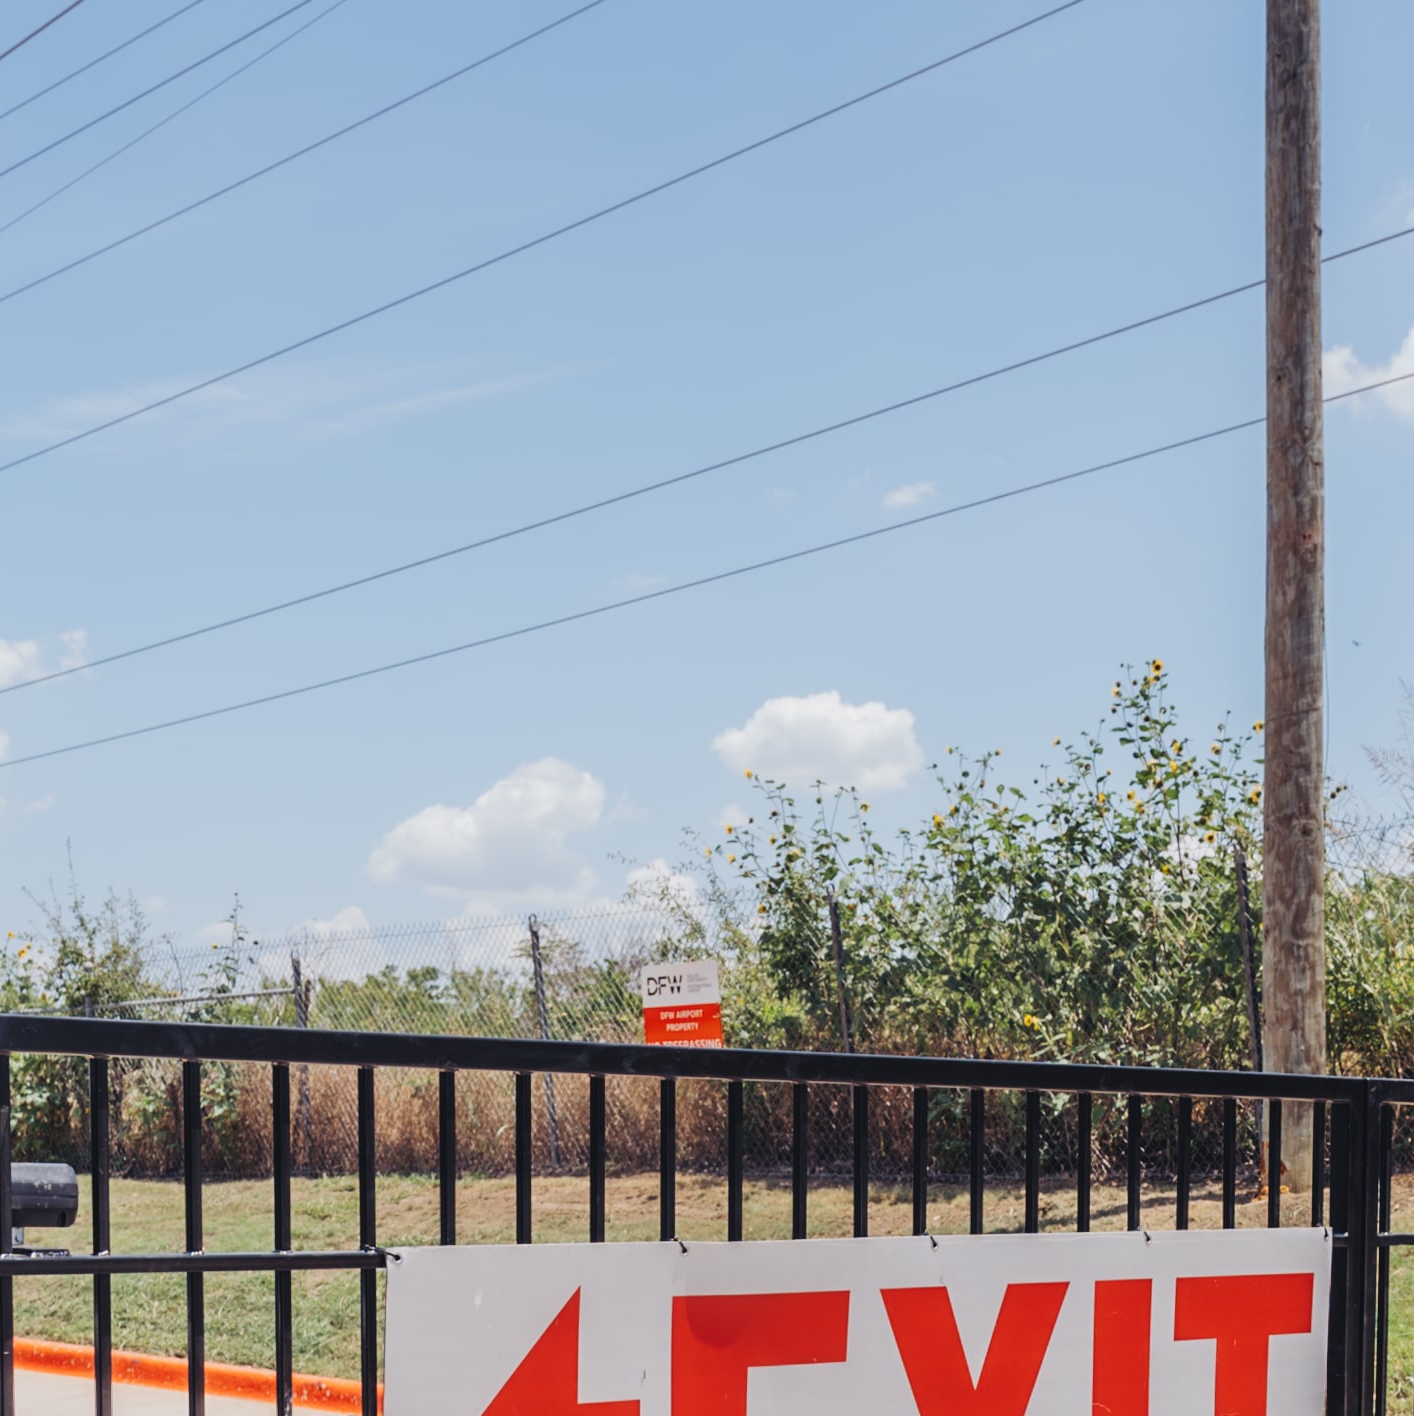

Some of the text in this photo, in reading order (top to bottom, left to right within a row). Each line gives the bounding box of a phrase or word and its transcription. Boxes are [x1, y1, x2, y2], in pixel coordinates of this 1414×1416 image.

[647, 975, 682, 995] DFW
[660, 1009, 703, 1020] DFW AIRPORT
[666, 1022, 699, 1031] PROPERTY
